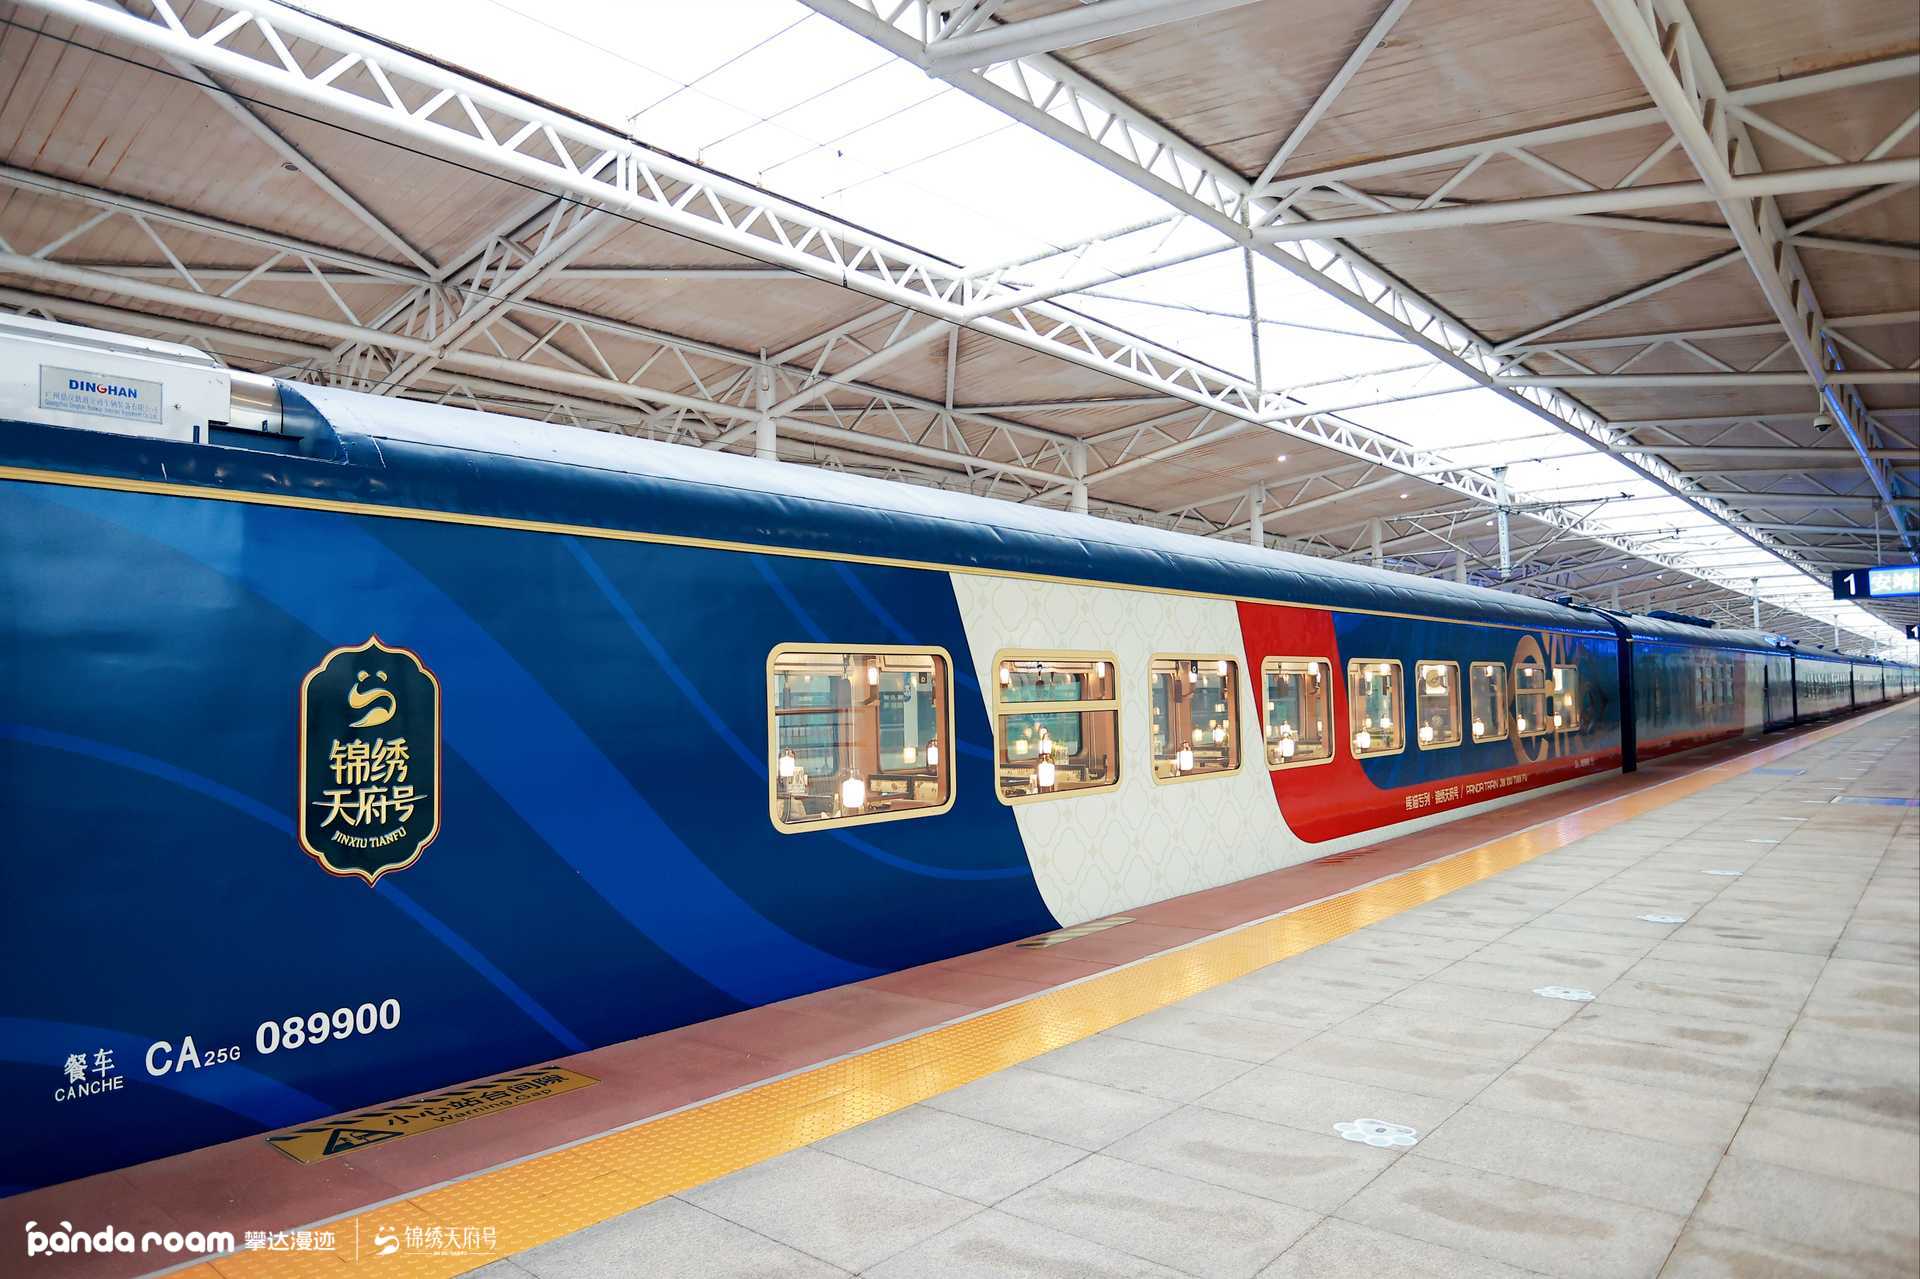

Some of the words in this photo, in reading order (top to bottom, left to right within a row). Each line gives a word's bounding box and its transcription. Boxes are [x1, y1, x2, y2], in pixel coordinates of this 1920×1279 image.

[69, 379, 137, 399] DINGHAN
[1844, 573, 1856, 595] 1
[1911, 626, 1918, 638] 1
[329, 738, 410, 785] 锦绣
[312, 785, 428, 827] 天府号
[331, 830, 368, 848] JINXIU
[370, 826, 407, 848] TIANFU
[255, 998, 401, 1055] 089900
[64, 1048, 115, 1084] 餐车
[55, 1075, 124, 1101] CANCHE
[388, 1073, 570, 1126] 小心站台间隙
